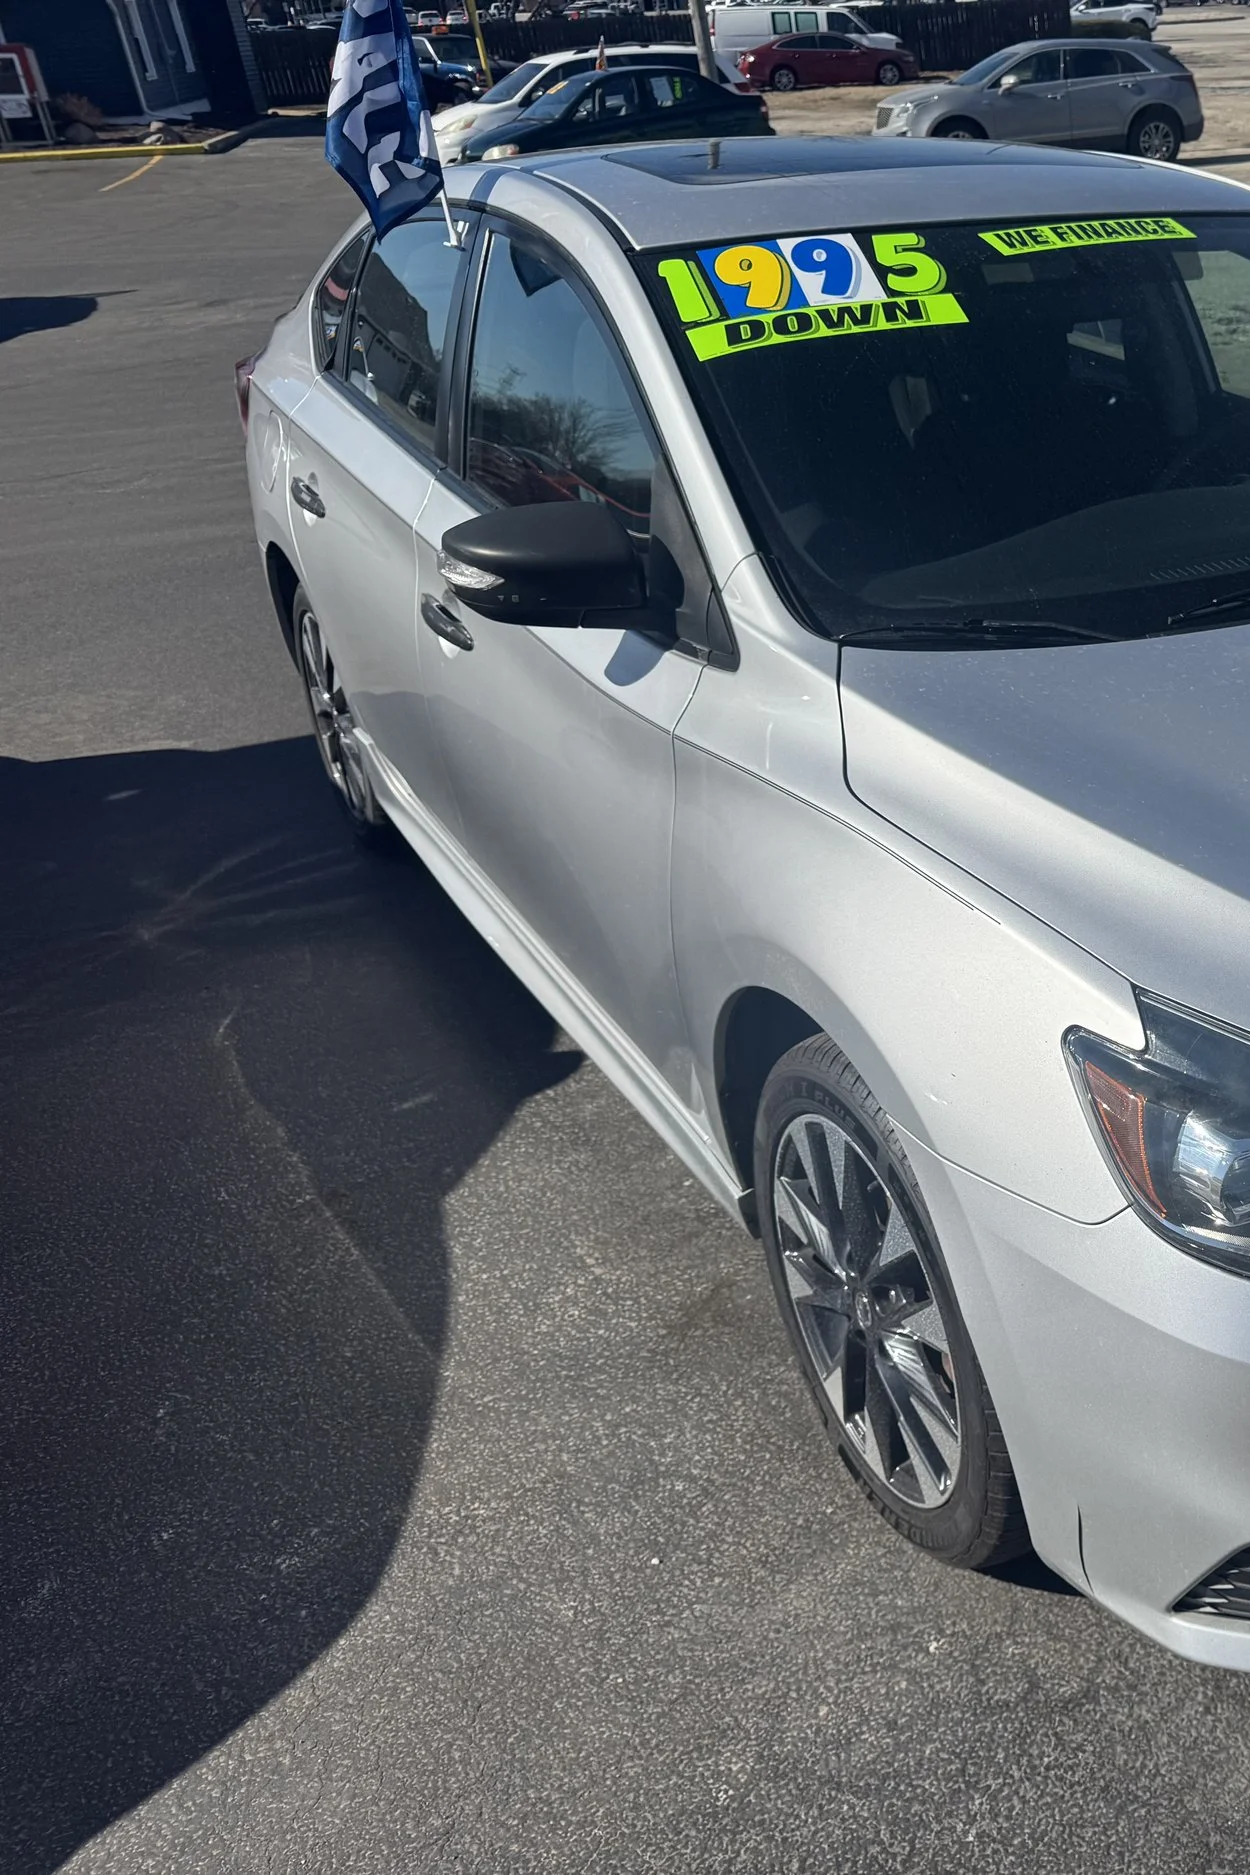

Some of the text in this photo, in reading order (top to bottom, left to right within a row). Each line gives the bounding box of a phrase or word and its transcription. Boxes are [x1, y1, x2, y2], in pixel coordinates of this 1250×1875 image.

[994, 219, 1182, 251] WE FINANCE
[657, 232, 947, 323] 1995
[724, 299, 931, 348] DOWN
